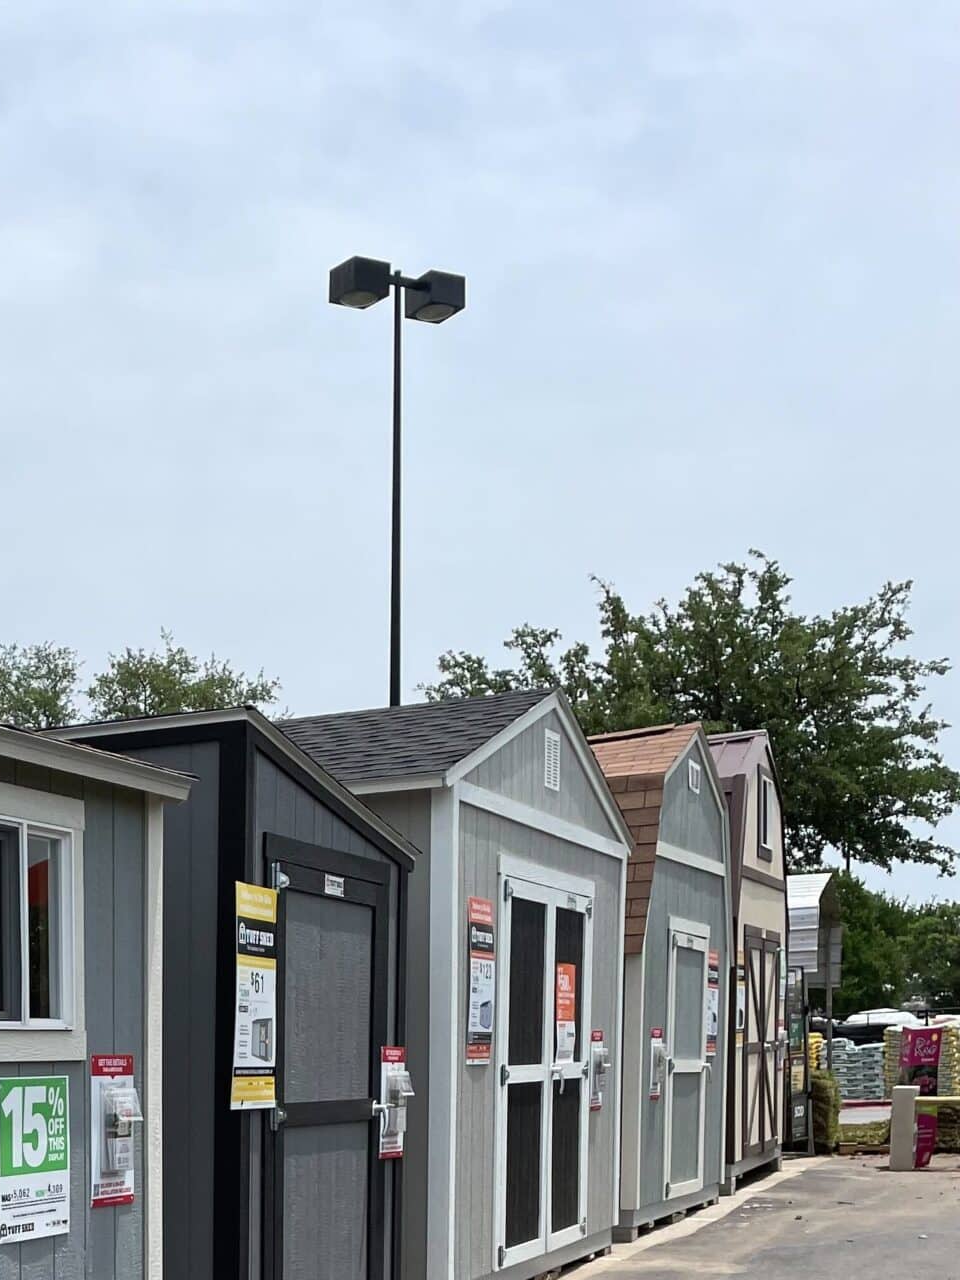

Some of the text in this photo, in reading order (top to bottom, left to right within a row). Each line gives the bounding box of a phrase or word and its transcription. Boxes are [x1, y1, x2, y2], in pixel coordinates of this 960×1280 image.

[246, 928, 274, 946] TUFF SHED
[250, 971, 264, 994] $61
[1, 1086, 64, 1169] 15 %
[48, 1117, 65, 1136] OFF
[48, 1136, 65, 1152] THIS
[8, 1224, 21, 1235] TUFF
[22, 1222, 34, 1233] SHED
